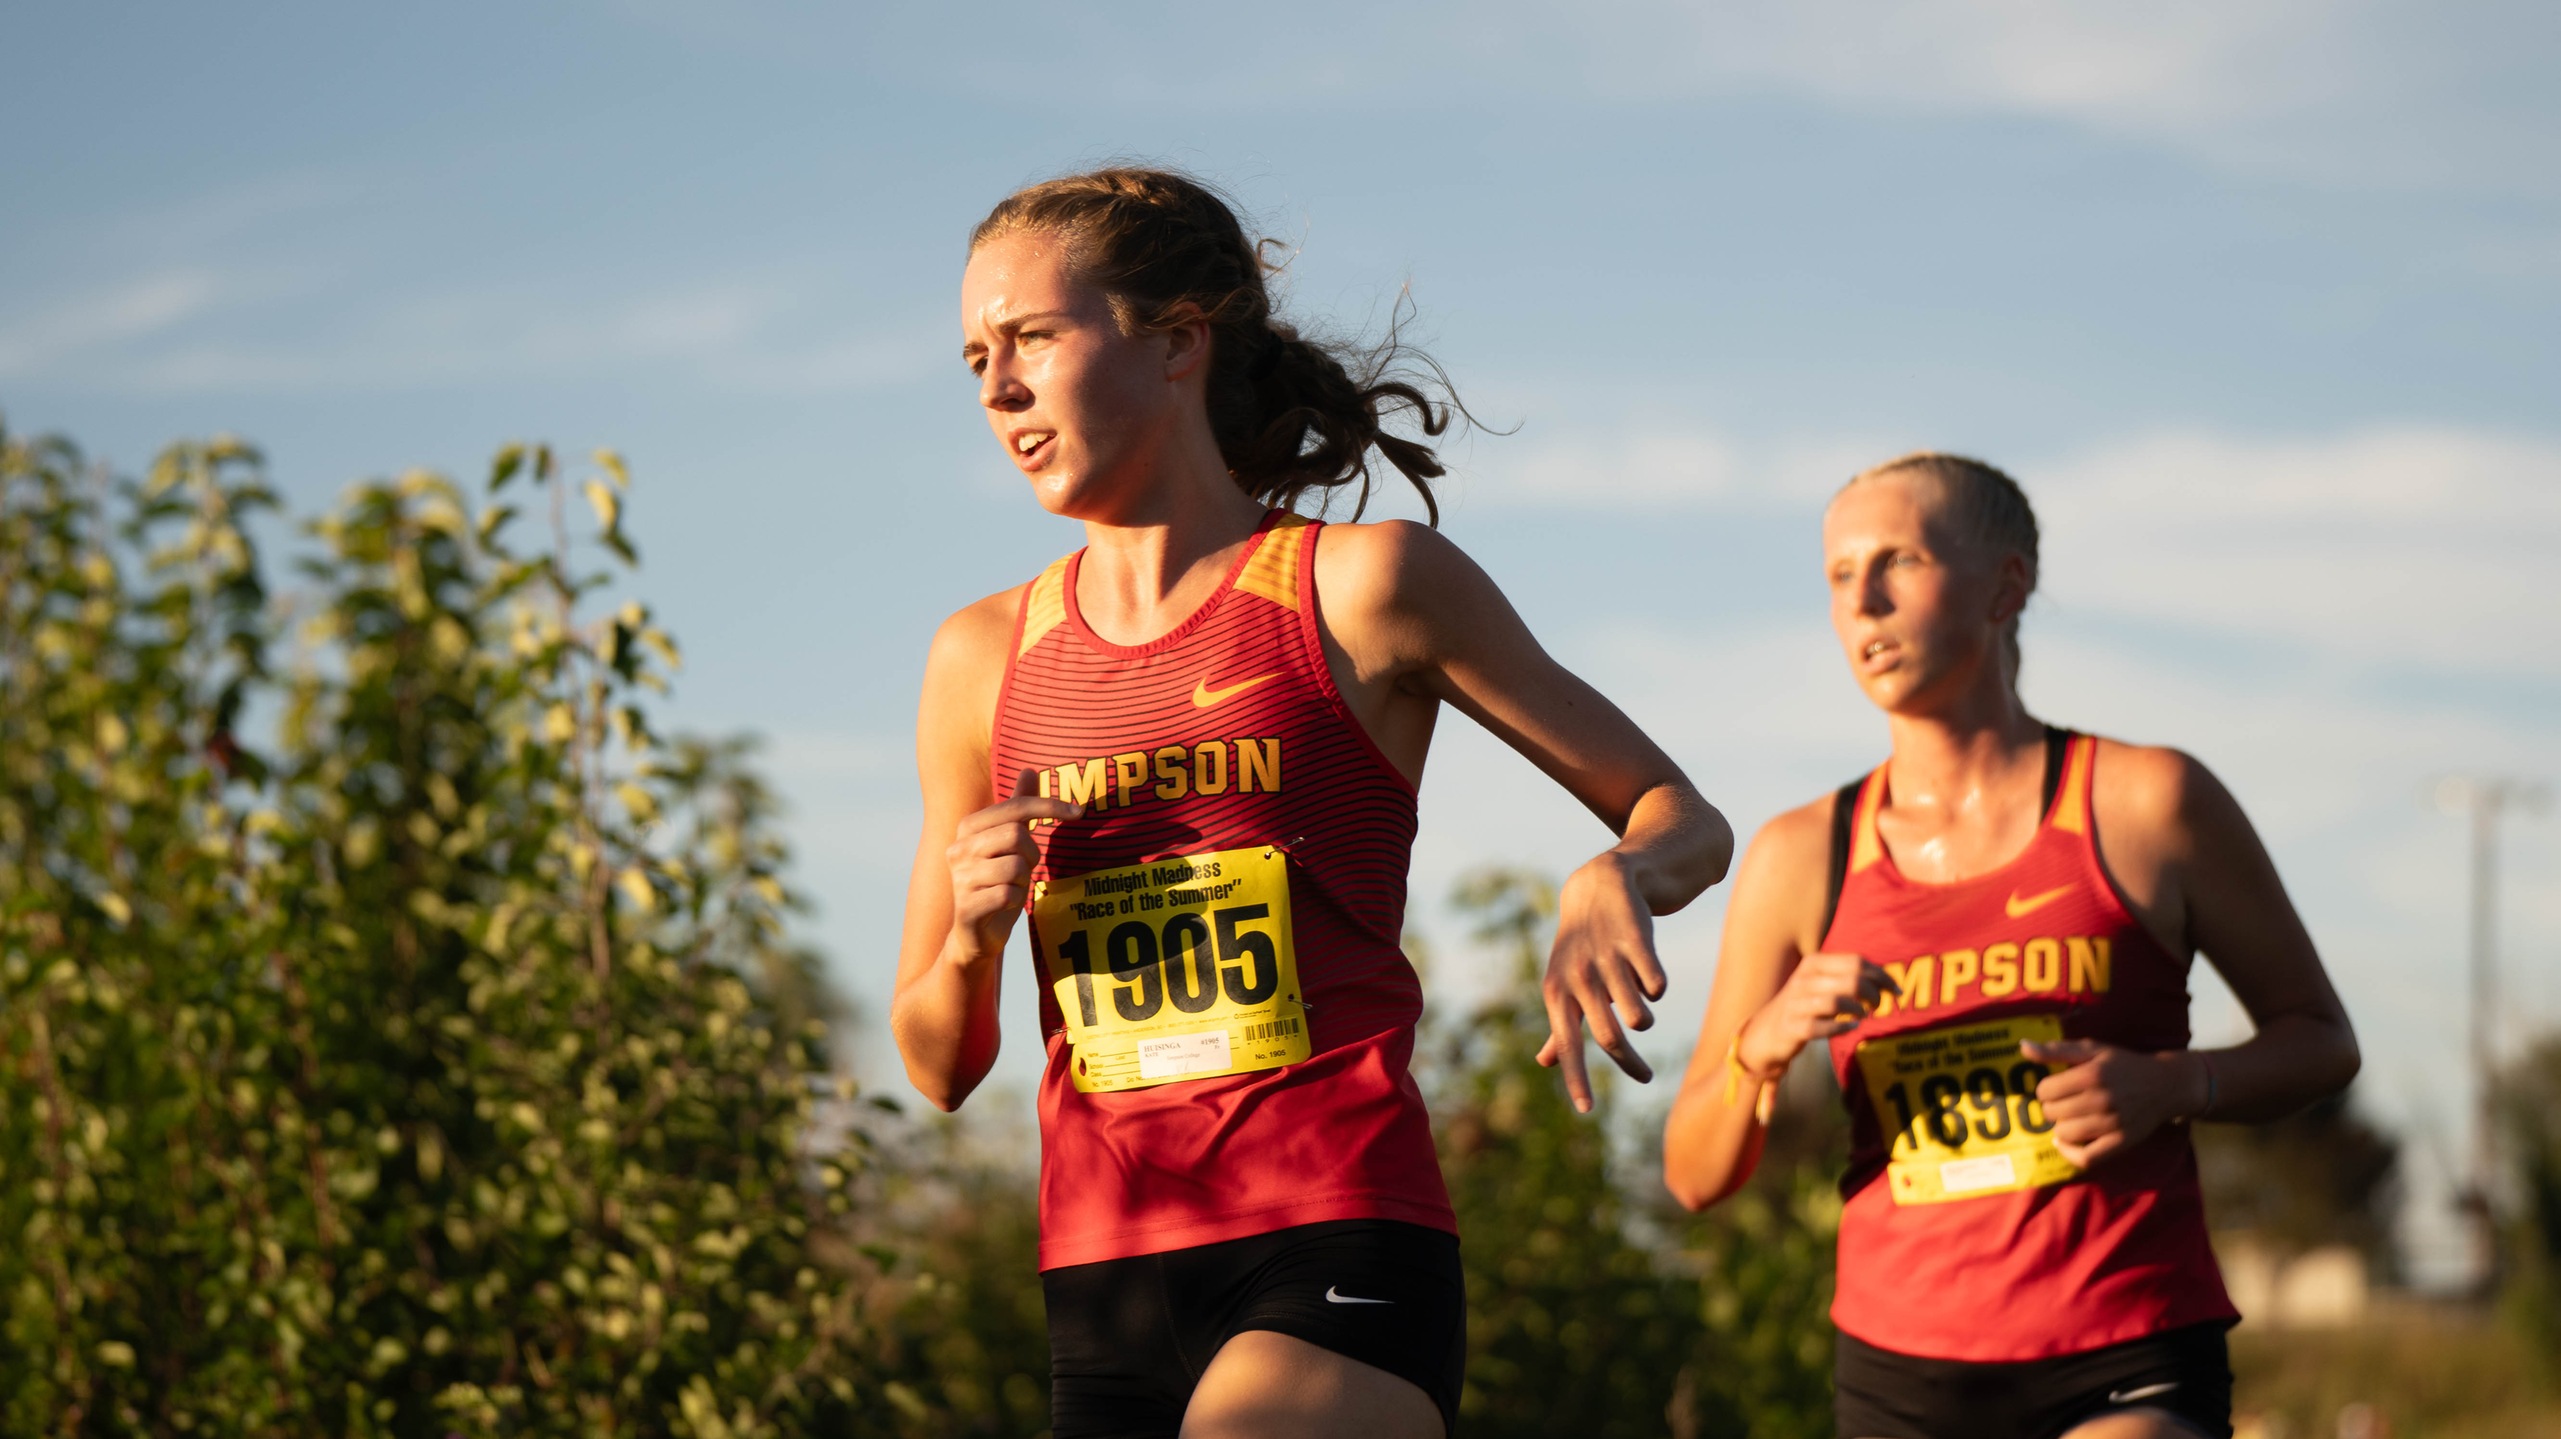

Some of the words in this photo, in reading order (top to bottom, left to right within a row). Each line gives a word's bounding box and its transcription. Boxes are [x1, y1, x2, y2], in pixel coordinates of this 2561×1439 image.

[1029, 738, 1281, 831] IMPSON
[1070, 902, 1115, 921] "Race
[1120, 897, 1134, 914] of
[1140, 893, 1164, 910] the
[1169, 878, 1242, 907] Summer"
[1084, 873, 1149, 897] Midnight
[1153, 862, 1221, 885] Madness
[1058, 903, 1278, 1026] 1905
[1834, 936, 2111, 1022] MPSON
[1269, 1049, 1286, 1058] 1905
[1885, 1062, 2056, 1150] 1898
